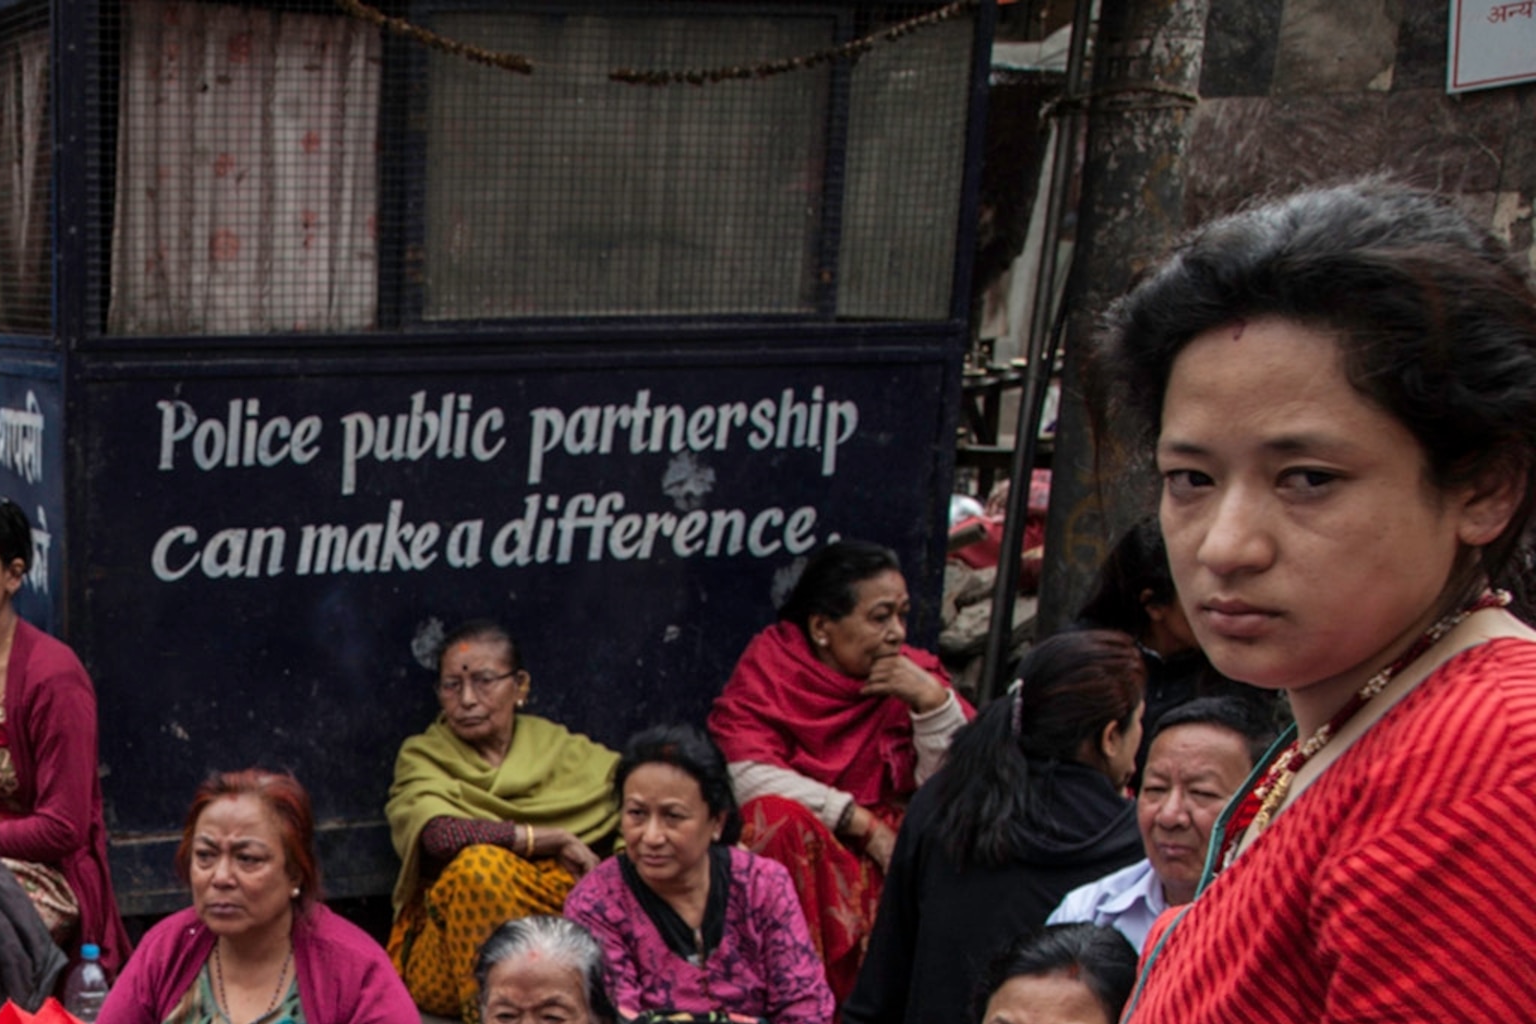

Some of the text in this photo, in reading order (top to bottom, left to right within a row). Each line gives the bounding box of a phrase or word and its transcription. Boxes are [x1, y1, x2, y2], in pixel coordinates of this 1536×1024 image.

[156, 385, 858, 495] Police public partnership
[151, 525, 286, 582] can
[296, 499, 441, 575] make
[446, 519, 484, 568] a
